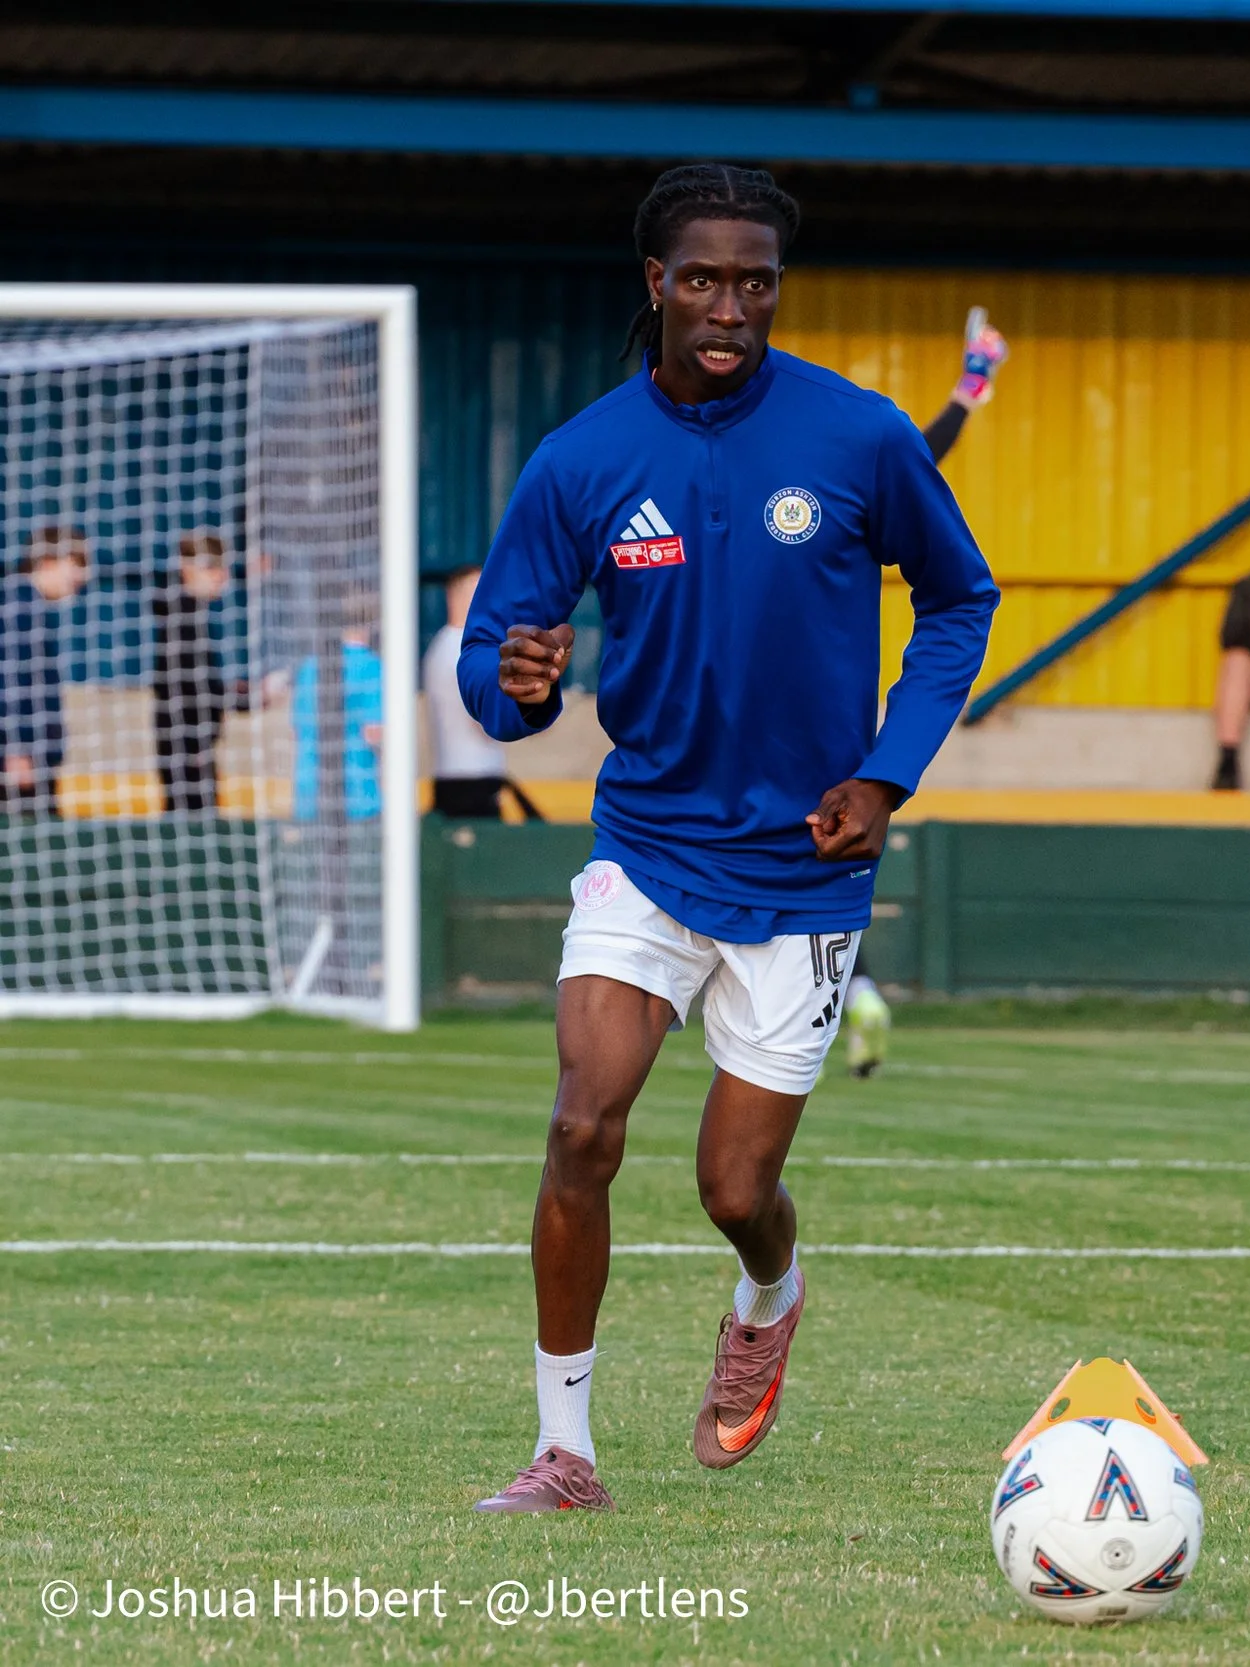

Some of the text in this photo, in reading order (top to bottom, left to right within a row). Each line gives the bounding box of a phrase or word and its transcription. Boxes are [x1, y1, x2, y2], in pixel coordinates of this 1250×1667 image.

[768, 489, 818, 511] CURZON ASHTON
[768, 521, 817, 542] FOOTBALL CLUB
